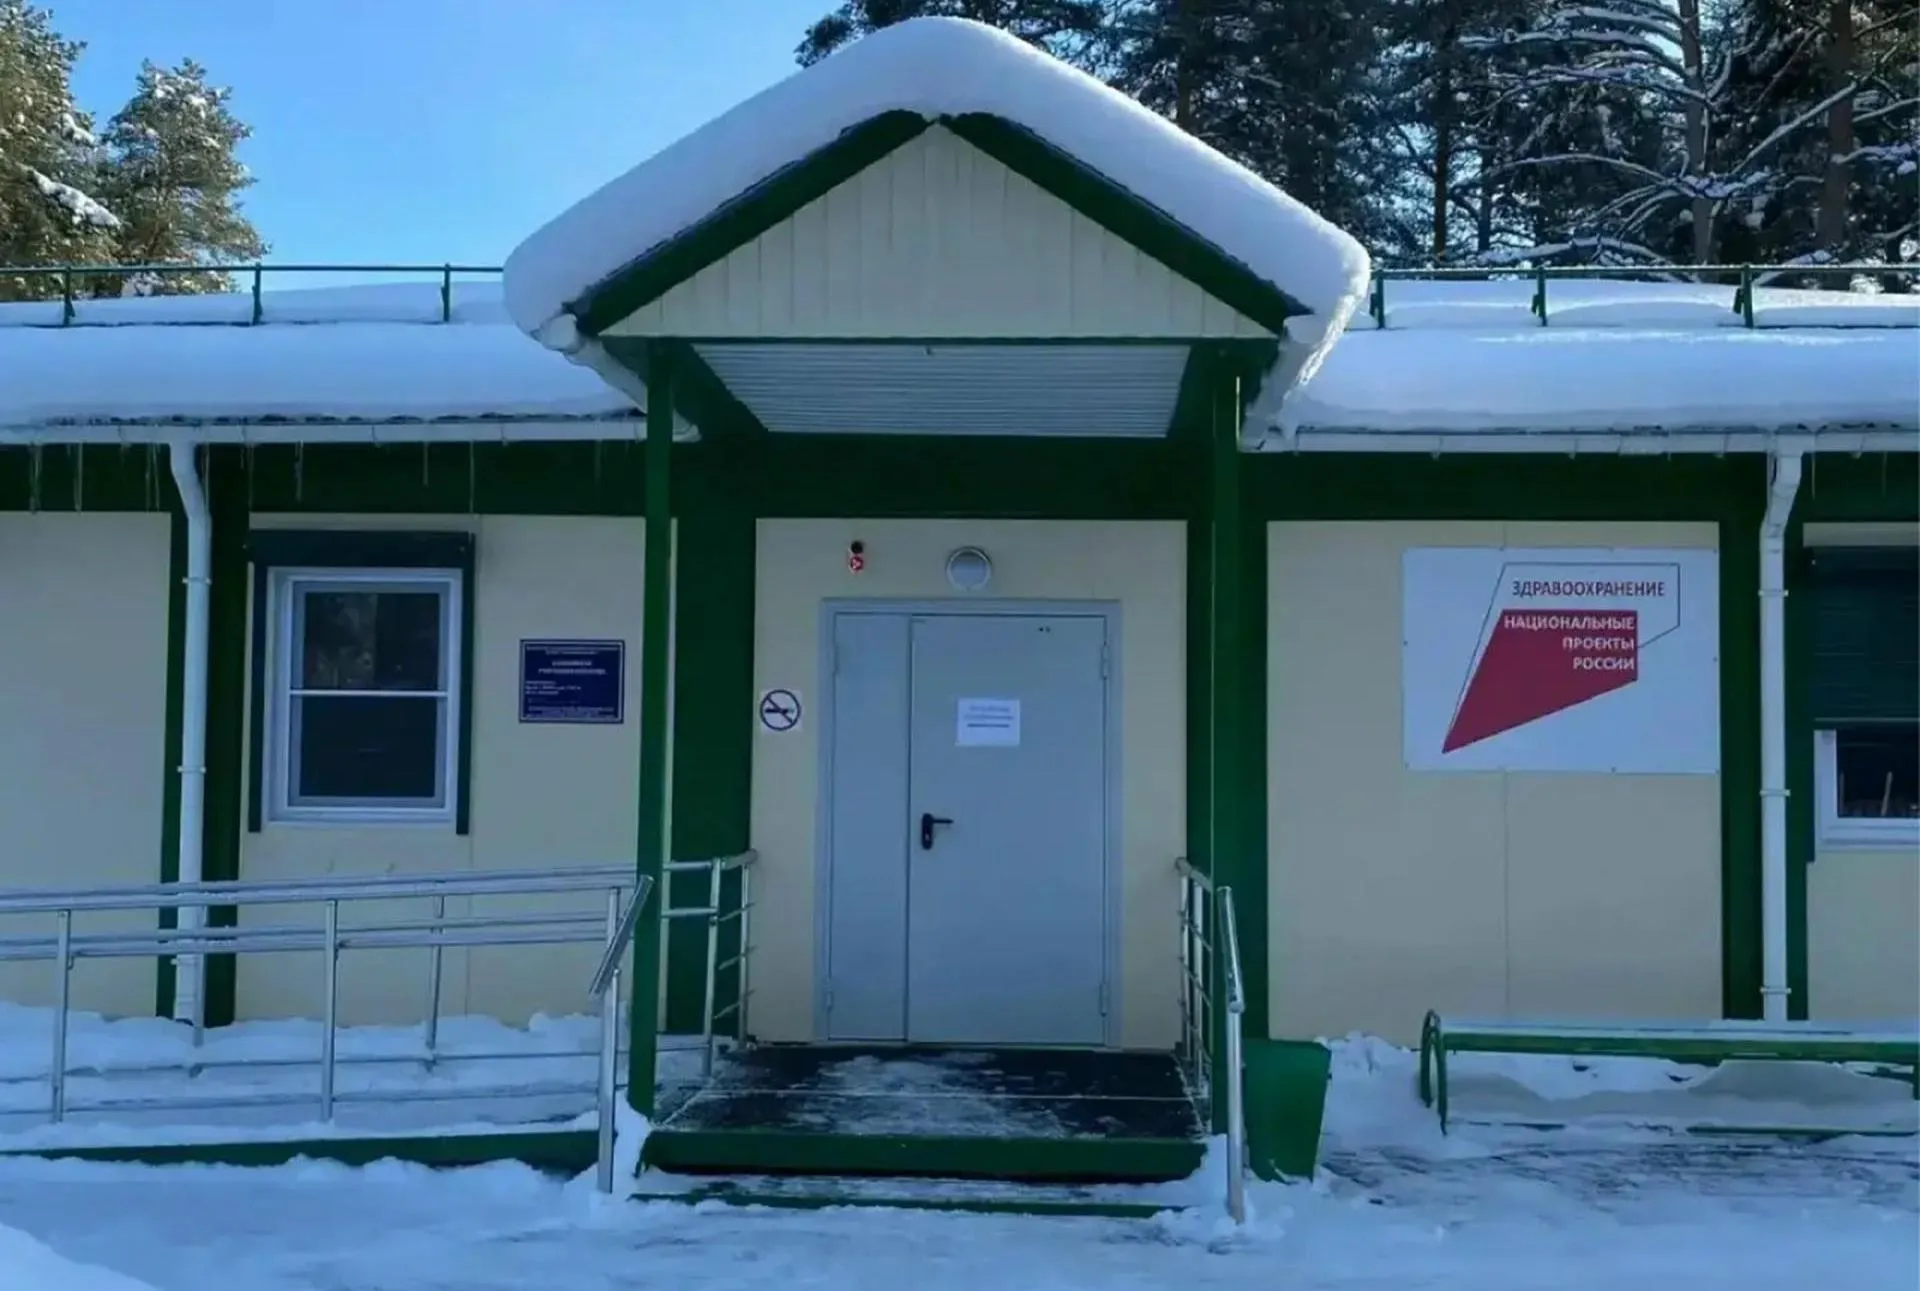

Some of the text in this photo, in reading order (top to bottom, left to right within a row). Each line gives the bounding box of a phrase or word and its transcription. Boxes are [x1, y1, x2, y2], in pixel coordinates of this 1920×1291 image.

[1511, 580, 1665, 598] ЗДРАВООХРАНЕНИЕ
[1503, 615, 1635, 631] НАЦИОНАЛЬНЫЕ
[1562, 636, 1635, 651] ПРОЕКТЫ
[1573, 656, 1635, 671] РОССИИ
